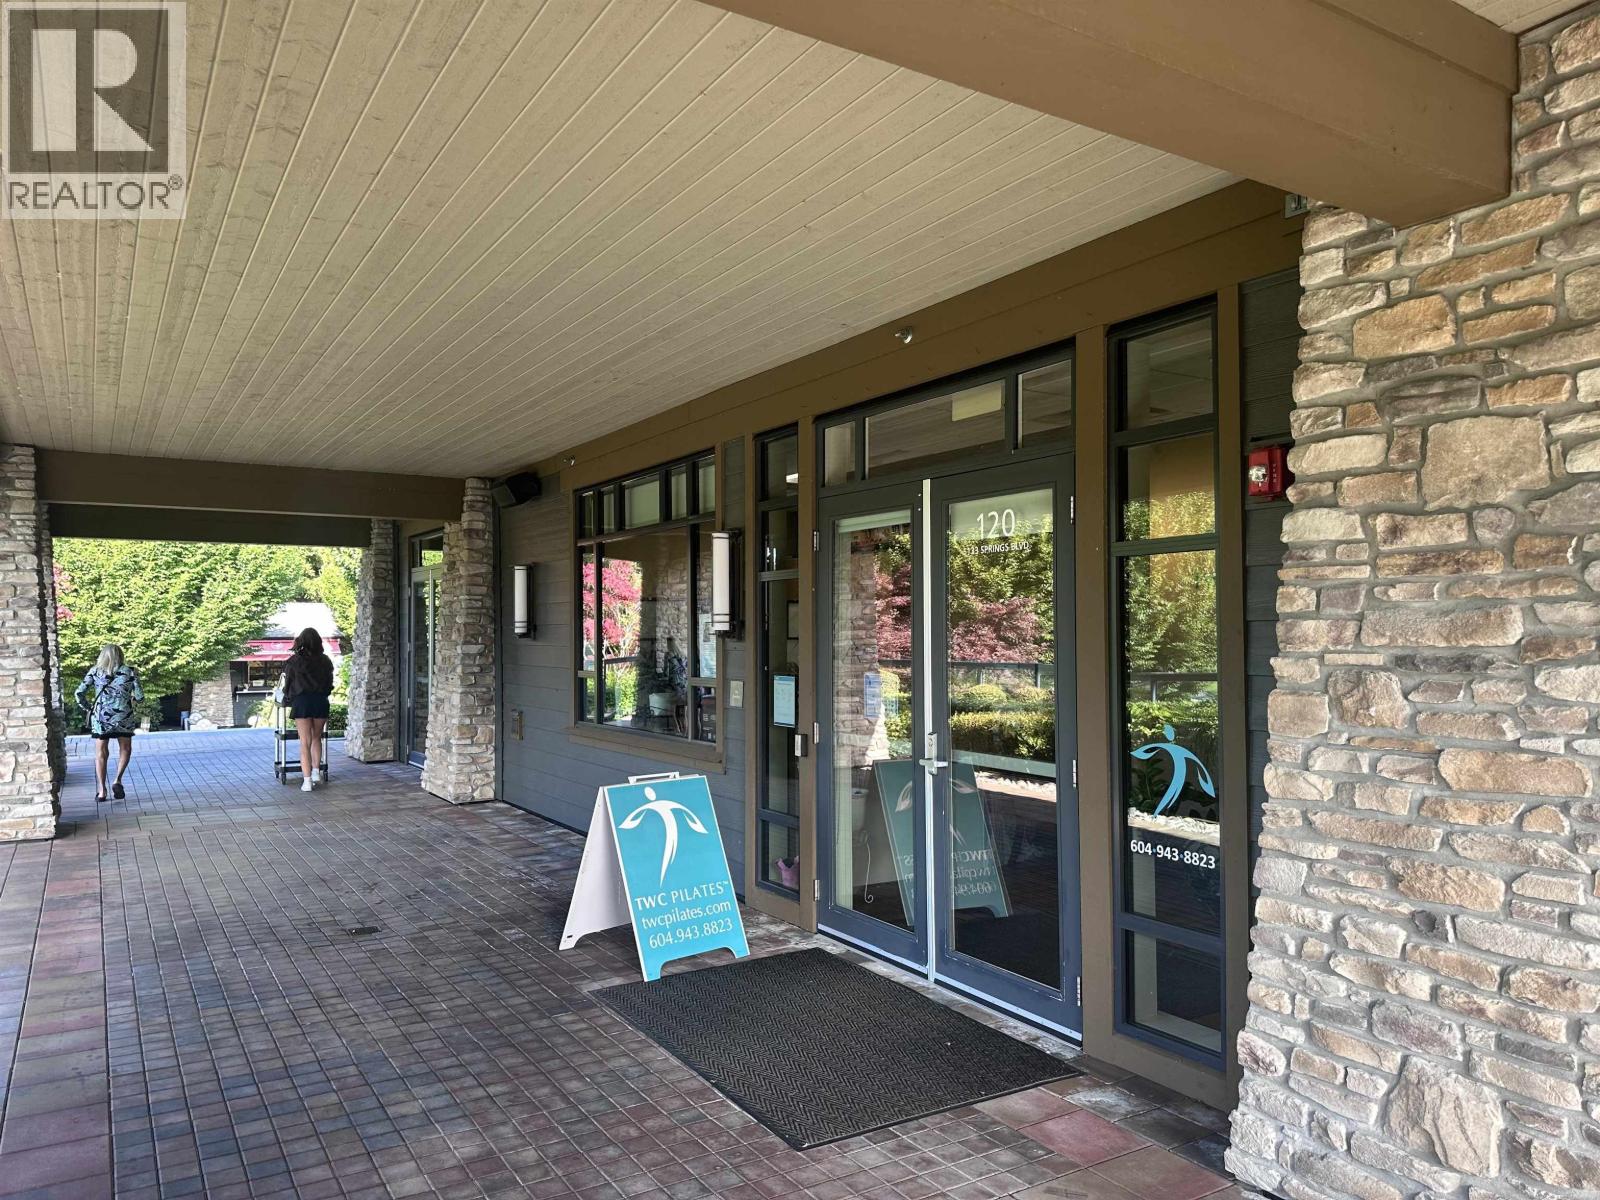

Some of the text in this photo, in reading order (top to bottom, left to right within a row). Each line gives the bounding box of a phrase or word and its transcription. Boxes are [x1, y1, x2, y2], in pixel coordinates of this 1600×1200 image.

[977, 508, 1015, 540] 120
[980, 543, 1009, 554] SPRINGS
[634, 892, 668, 911] TWC
[642, 901, 731, 929] twcpilates.com
[649, 918, 733, 949] 604.943.8823
